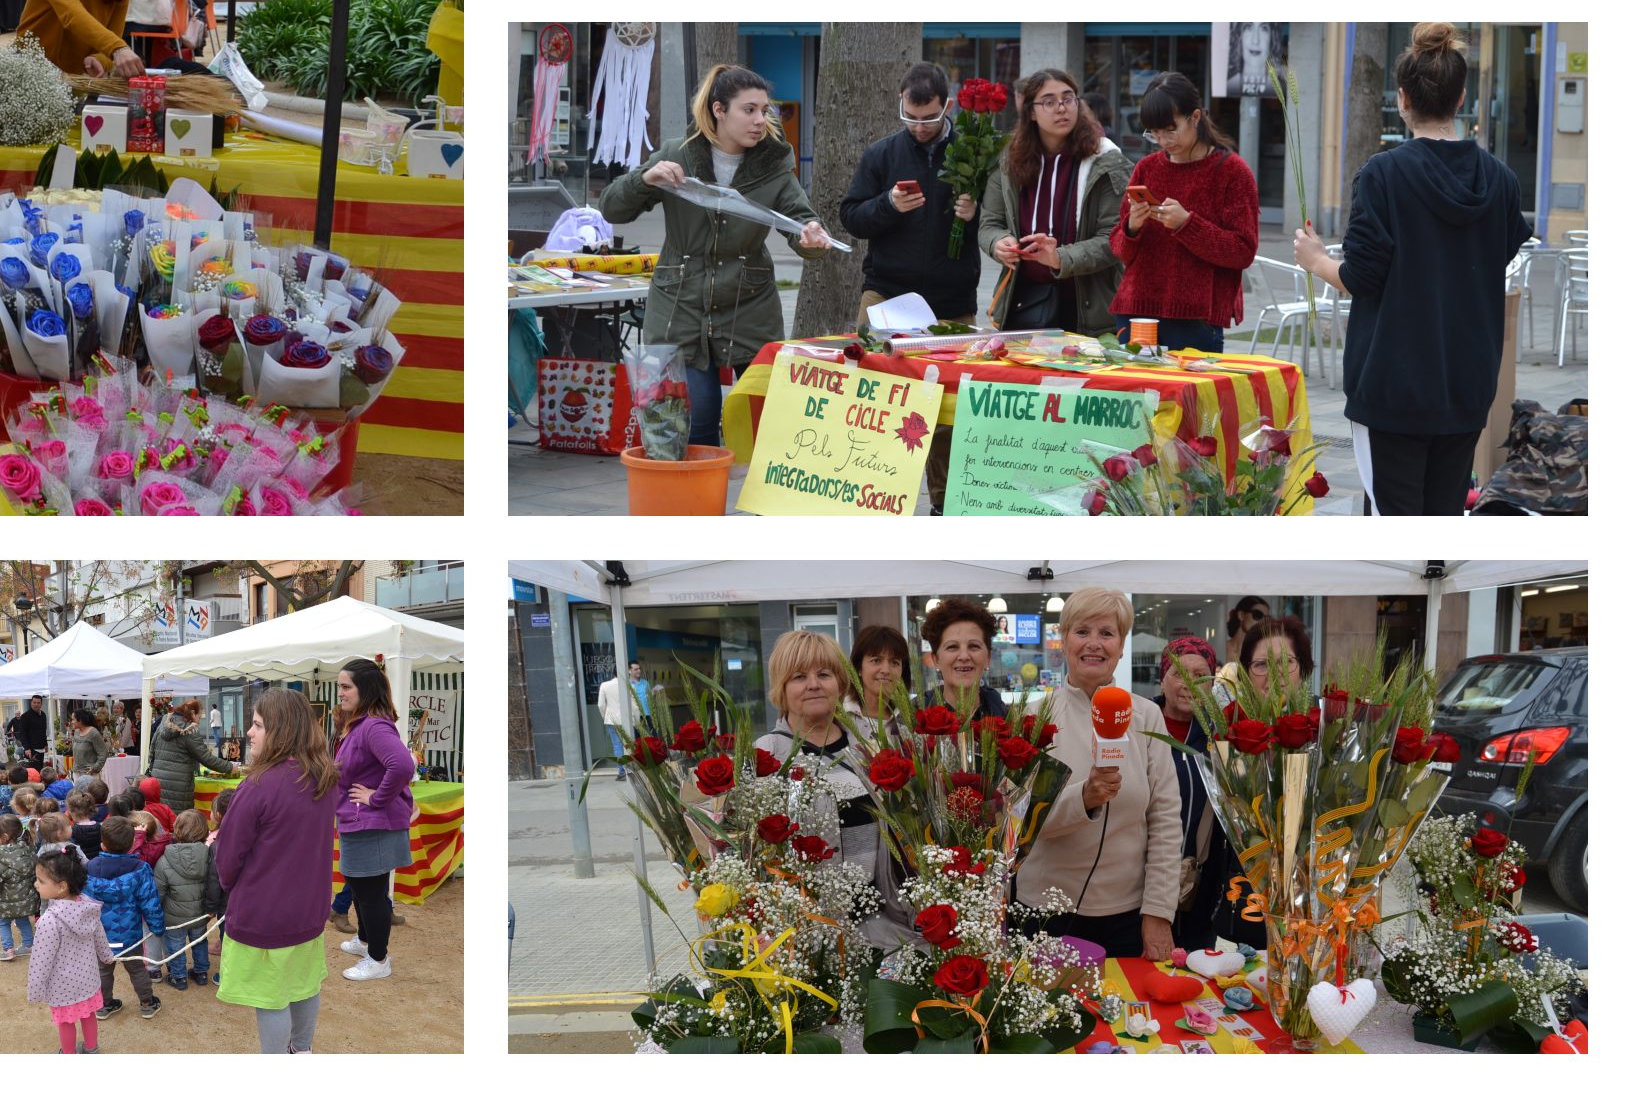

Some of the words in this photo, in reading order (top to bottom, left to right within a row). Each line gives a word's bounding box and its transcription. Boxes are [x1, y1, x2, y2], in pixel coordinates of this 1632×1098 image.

[857, 377, 881, 401] DE
[804, 395, 829, 419] DE
[1042, 393, 1066, 423] AL
[1073, 395, 1143, 429] MARROC
[550, 440, 597, 450] Palafolls
[786, 429, 833, 460] Pels
[834, 430, 898, 476] Futurs
[964, 427, 978, 444] La
[985, 434, 1024, 453] finalitat
[1032, 437, 1067, 458] d'aquest
[964, 454, 976, 470] fer
[983, 457, 1038, 472] intervencions
[1043, 464, 1054, 473] en
[1060, 466, 1095, 478] centres
[986, 501, 1003, 510] amb
[409, 695, 446, 714] RCLE
[427, 718, 441, 726] Mar
[1467, 770, 1498, 780] QASHQAI
